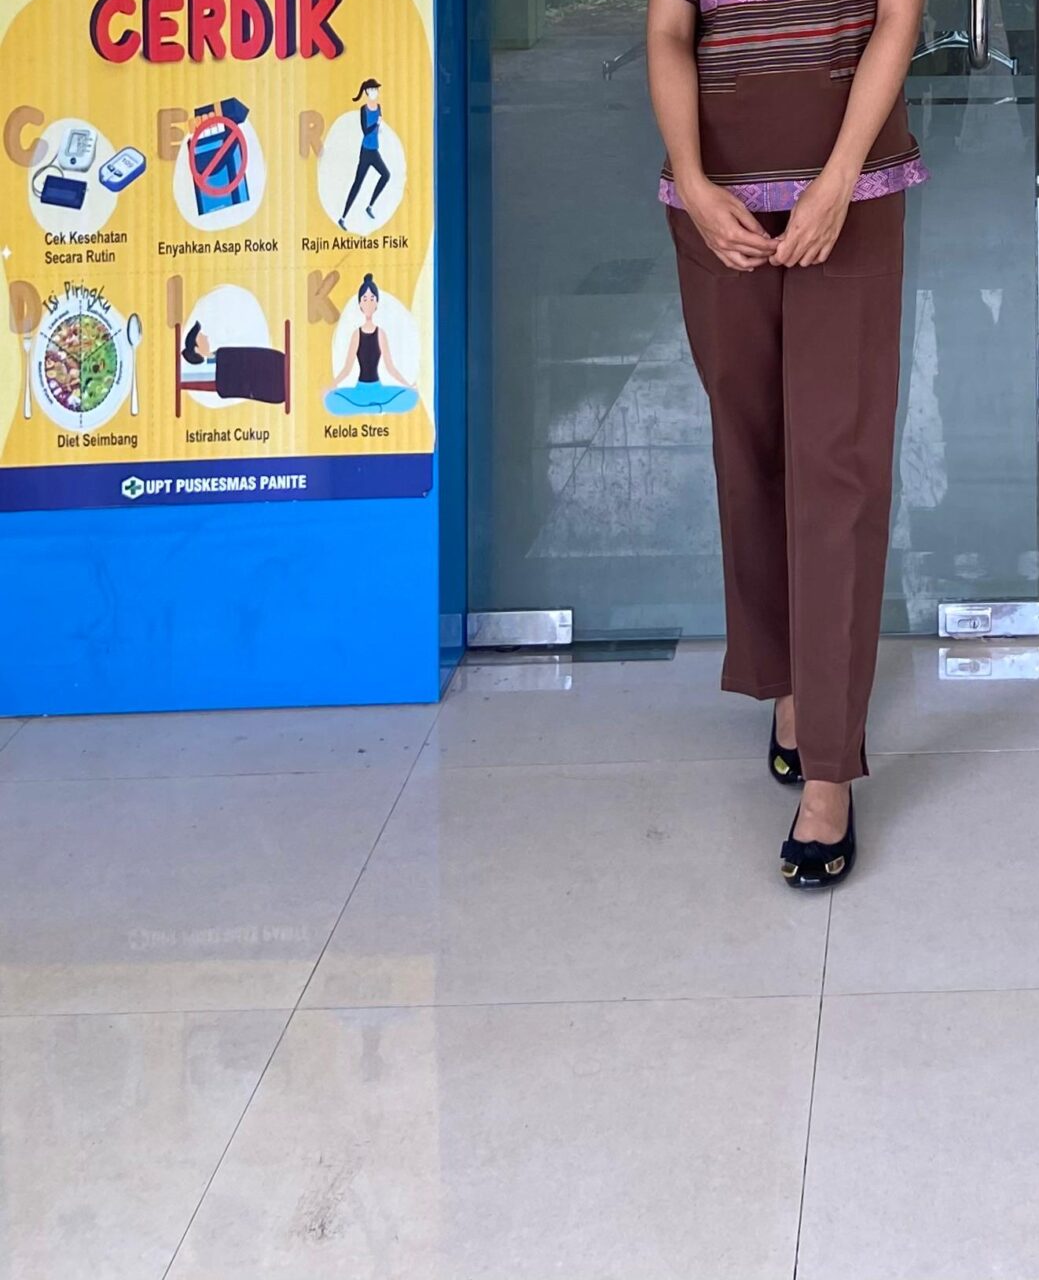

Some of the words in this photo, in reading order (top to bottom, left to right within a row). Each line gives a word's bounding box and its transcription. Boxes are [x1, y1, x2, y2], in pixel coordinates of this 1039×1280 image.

[45, 231, 66, 245] Cek
[69, 231, 127, 245] Kesehatan
[302, 236, 330, 253] Rajin
[332, 236, 379, 250] Aktivitas
[382, 235, 408, 248] Fisik
[158, 239, 211, 257] Enyahkan
[214, 238, 241, 255] Asap
[244, 238, 279, 253] Rokok
[45, 251, 83, 264] Secara
[86, 249, 115, 263] Rutin
[43, 290, 59, 314] Isi
[64, 279, 111, 315] Piringku
[186, 429, 231, 443] Istirahat
[234, 428, 270, 443] Cukup
[324, 424, 359, 439] Kelola
[361, 424, 390, 438] Stres
[57, 433, 79, 448] Diet
[82, 433, 138, 449] Seimbang
[146, 479, 173, 496] UPT
[176, 476, 256, 494] PUSKESMAS
[260, 475, 307, 491] PANITE
